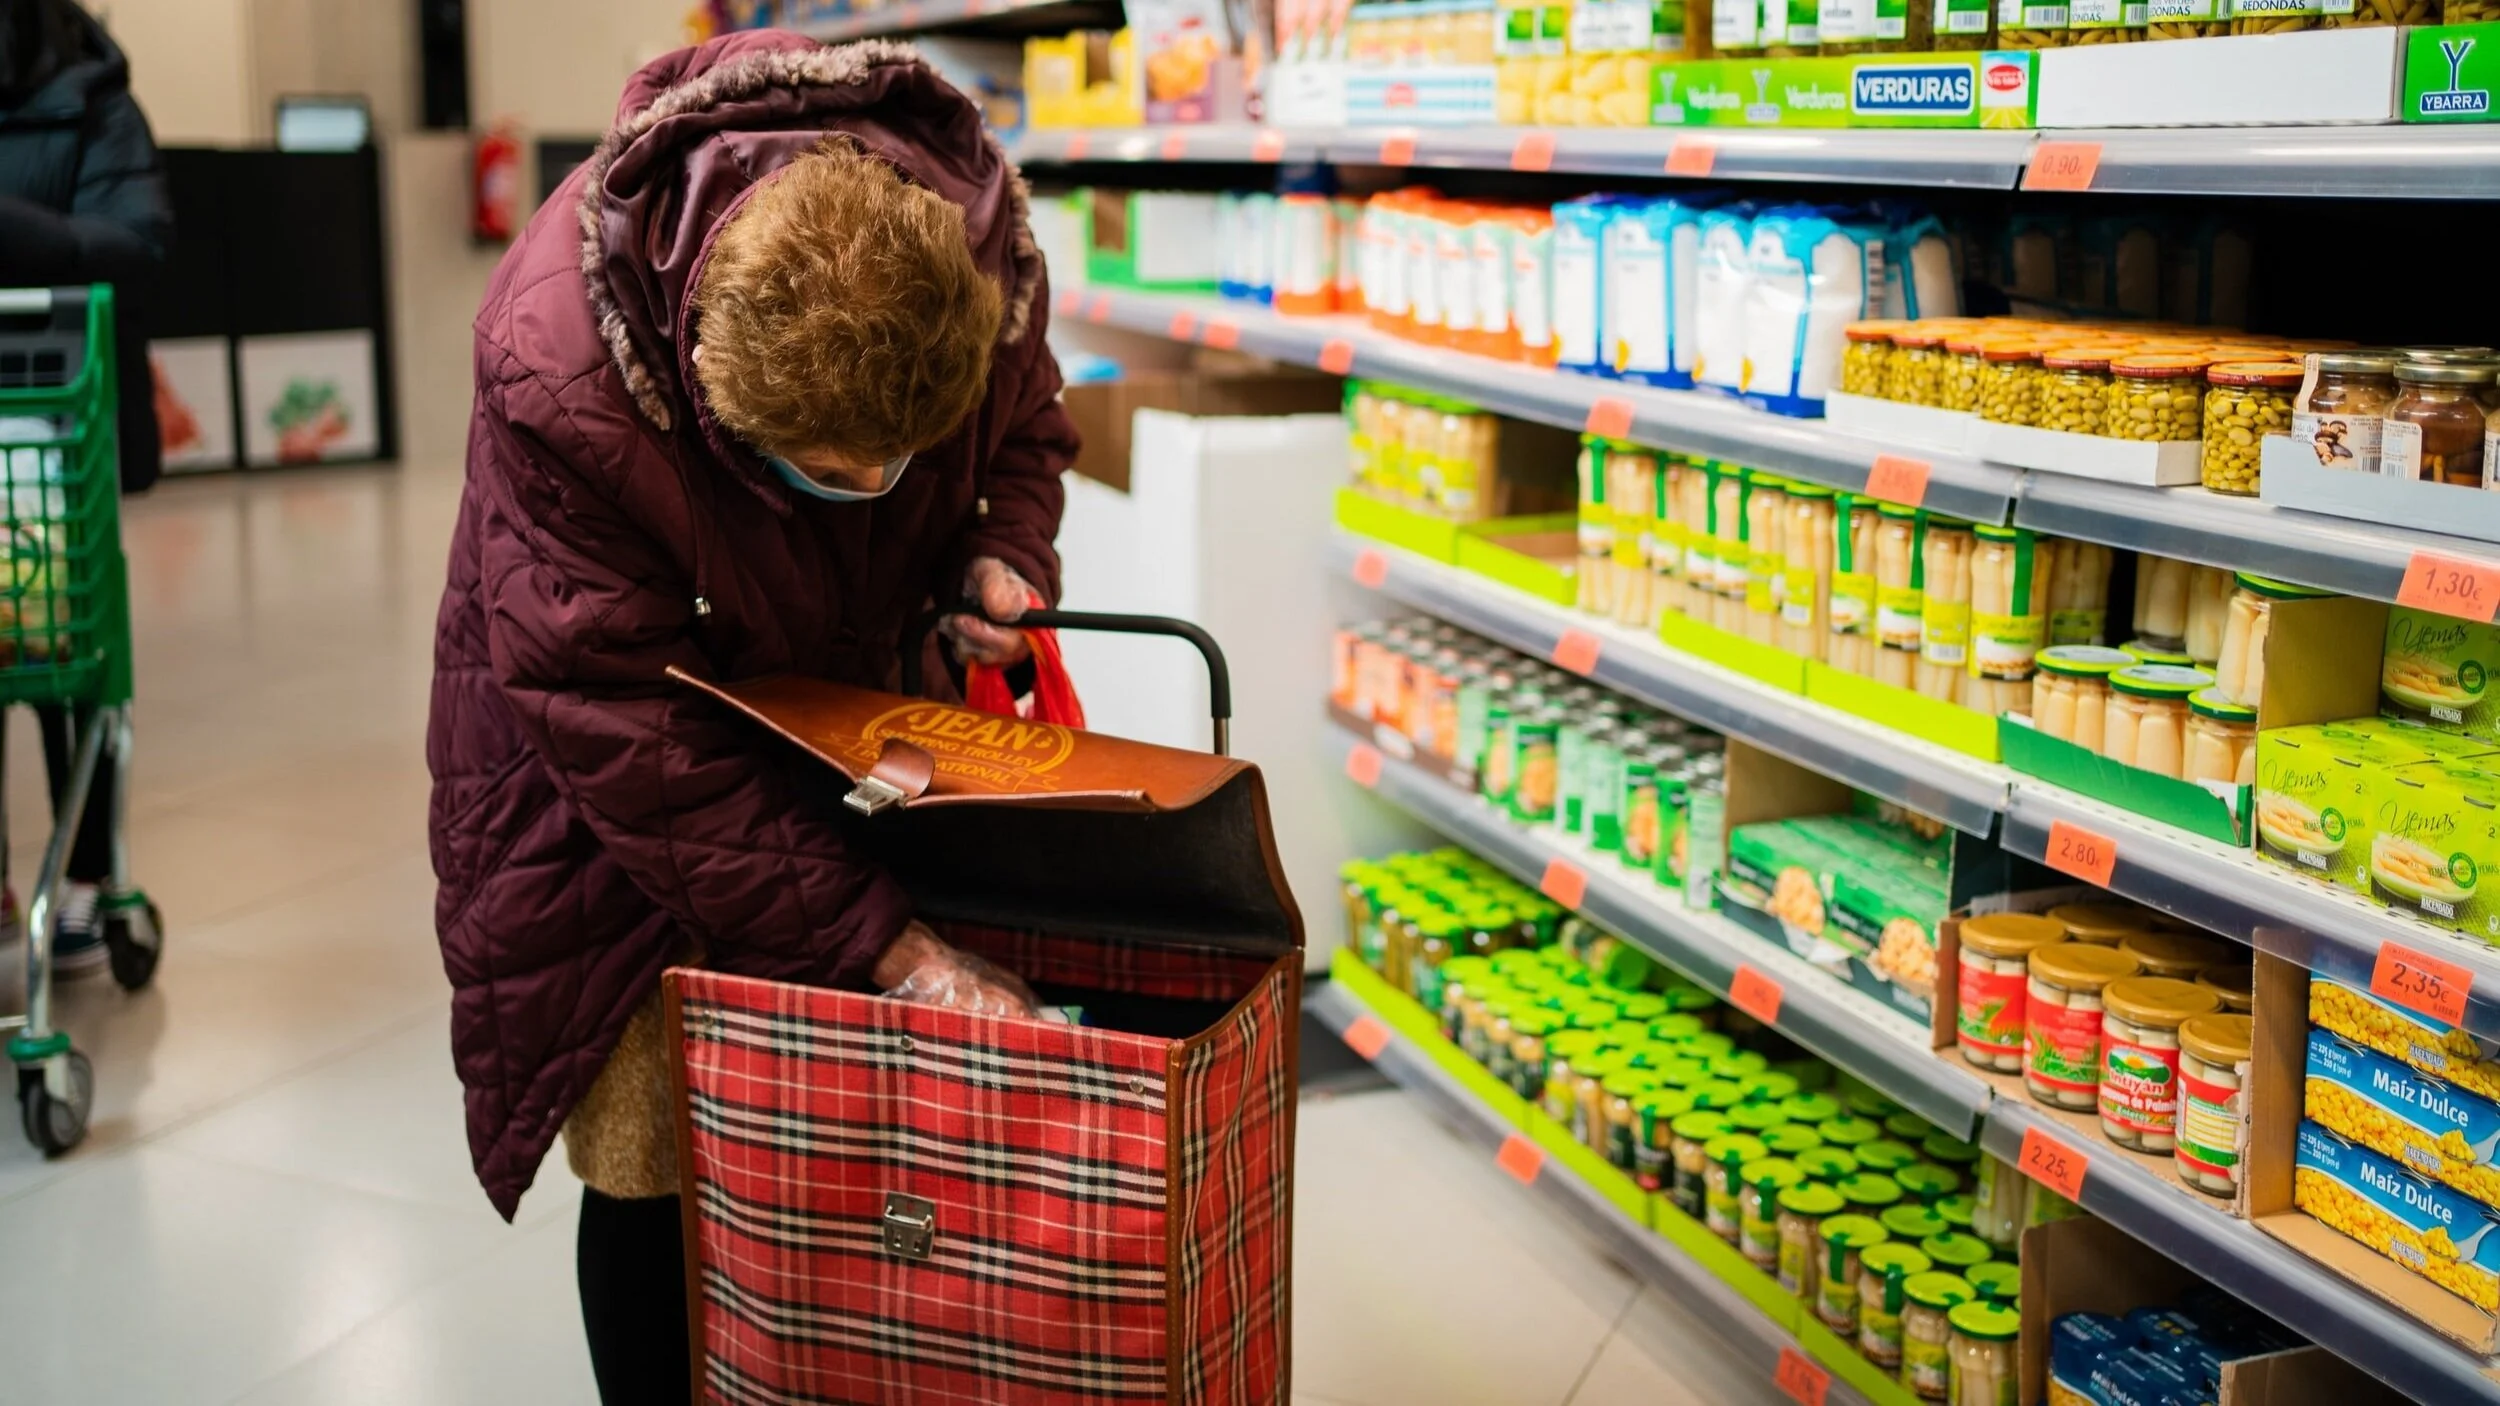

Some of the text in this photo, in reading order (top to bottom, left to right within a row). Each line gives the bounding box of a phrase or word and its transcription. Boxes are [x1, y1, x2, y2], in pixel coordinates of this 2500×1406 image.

[2242, 0, 2306, 11] REDONDAS
[2439, 38, 2475, 91] Y
[1784, 82, 1846, 109] Verduras
[1857, 77, 1970, 103] VERDURAS
[2424, 94, 2484, 110] YBARRA
[2425, 567, 2483, 601] 1,30€
[910, 708, 1046, 751] JEAN
[962, 745, 1040, 768] TROLLEY
[2380, 800, 2458, 840] Yemas
[2487, 827, 2496, 839] 2
[2429, 864, 2448, 878] YEMAS
[2479, 863, 2499, 875] YEMAS
[2421, 897, 2455, 919] HACENDADO
[2390, 962, 2450, 1004] 2,35€
[2409, 1044, 2447, 1070] HACENDADO
[2373, 1068, 2469, 1128] Maíz Dulce
[2360, 1161, 2453, 1225] Maíz Dulce
